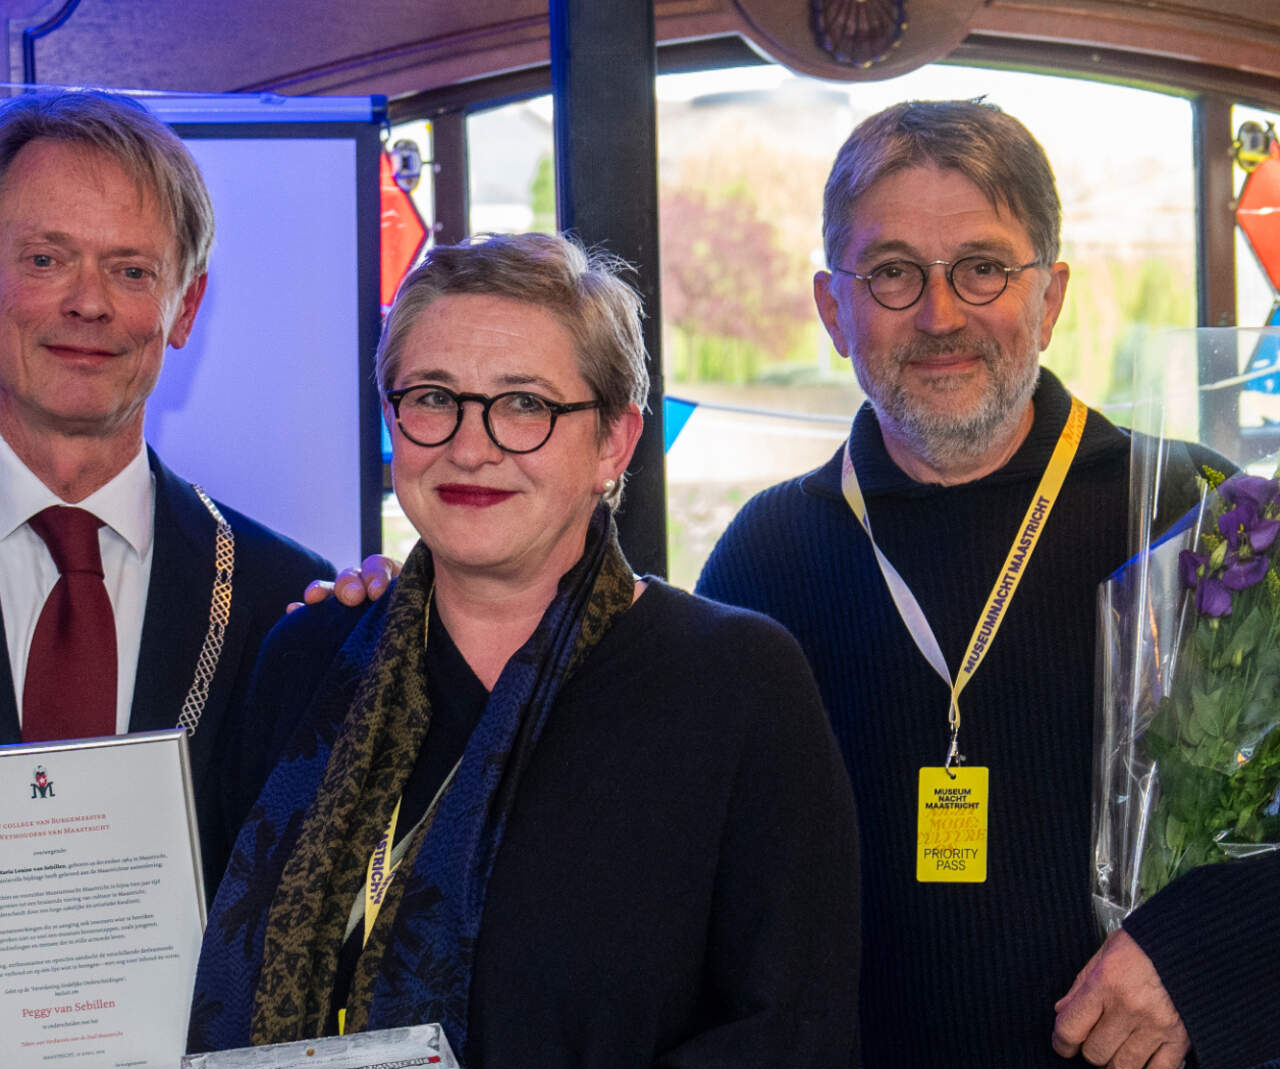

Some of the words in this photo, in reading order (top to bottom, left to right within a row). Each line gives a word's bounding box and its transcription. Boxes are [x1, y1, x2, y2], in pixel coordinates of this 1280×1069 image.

[963, 572, 1016, 674] MUSEUMNACHT
[1010, 494, 1051, 574] MAASTRICHT
[933, 787, 972, 796] MUSEUM
[938, 795, 967, 803] NACHT
[925, 801, 980, 810] MAASTRICHT
[923, 848, 978, 860] PRIORITY
[936, 859, 966, 871] PASS
[22, 1006, 52, 1019] Peggy
[54, 1004, 72, 1014] van
[74, 999, 116, 1012] Sebillen
